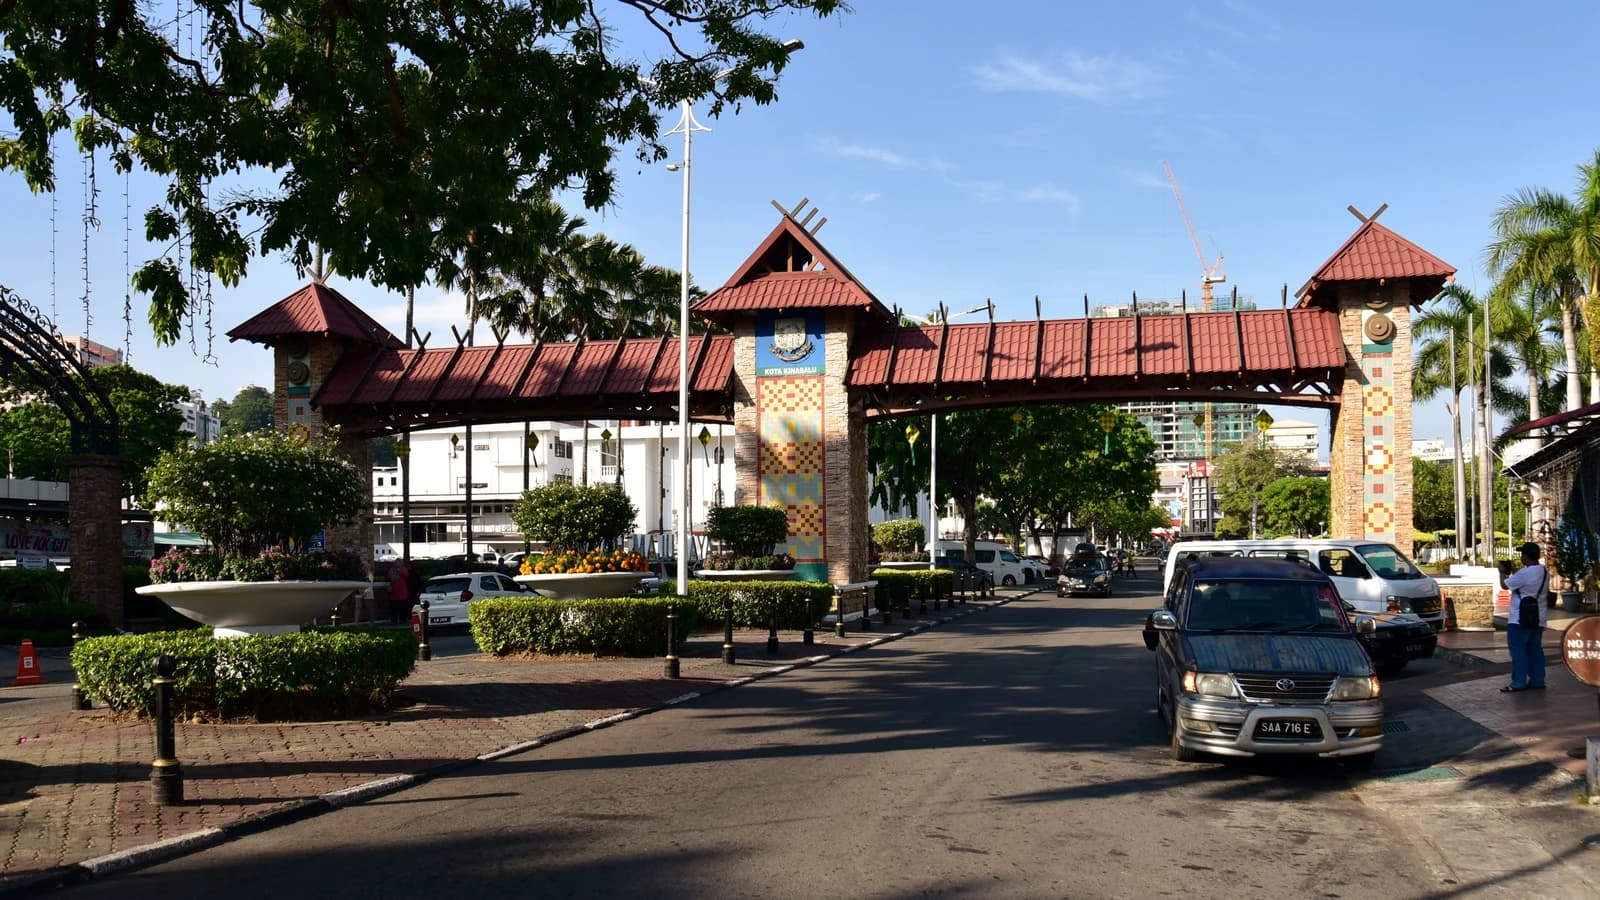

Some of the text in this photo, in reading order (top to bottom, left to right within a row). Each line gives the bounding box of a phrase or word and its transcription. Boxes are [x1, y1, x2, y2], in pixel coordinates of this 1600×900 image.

[783, 366, 817, 374] KINABALU
[6, 533, 70, 552] LOVE KK CIT
[1567, 639, 1584, 648] NO
[1262, 722, 1311, 734] SAA 716 E
